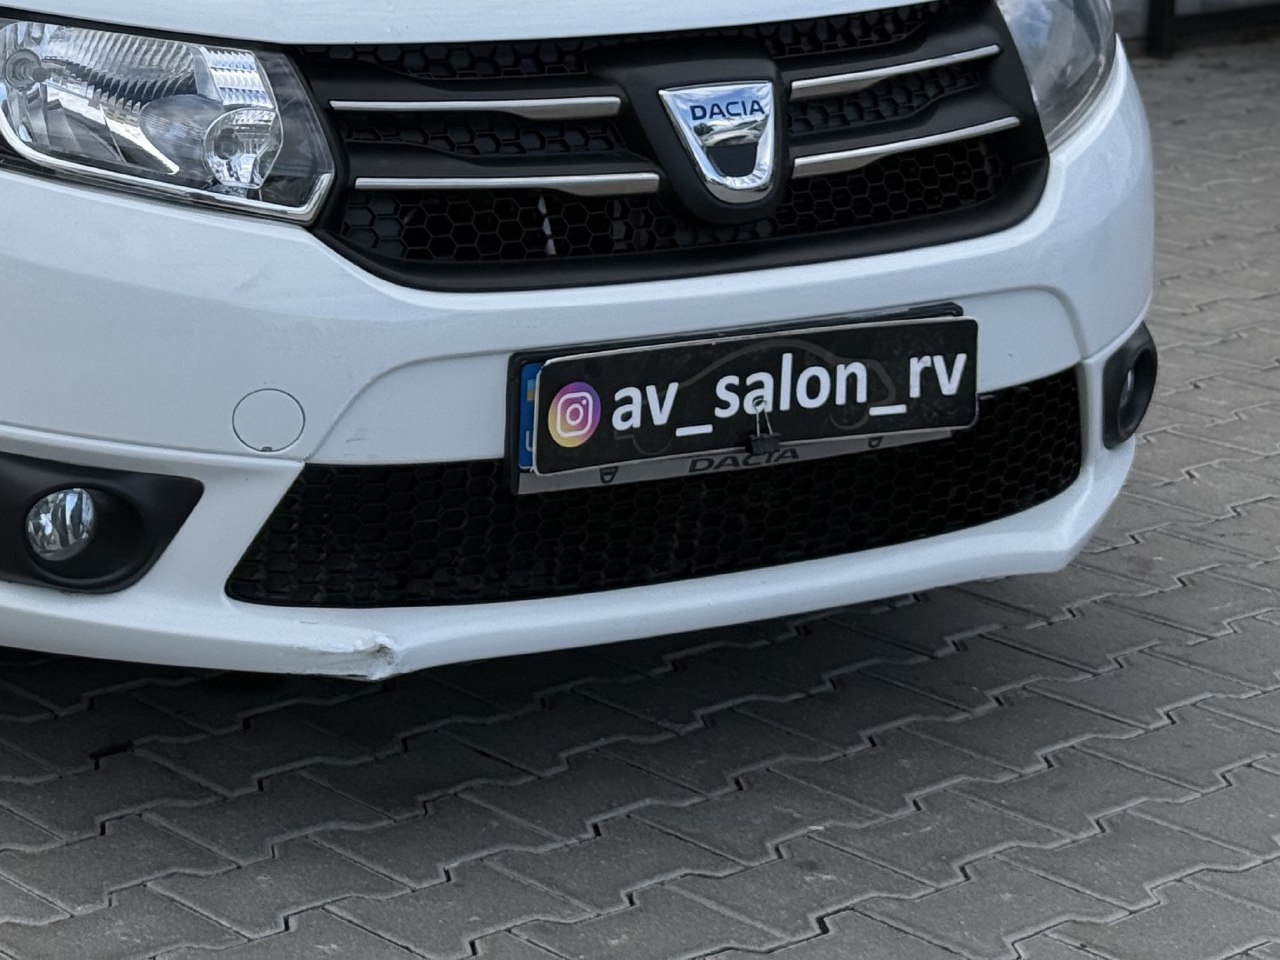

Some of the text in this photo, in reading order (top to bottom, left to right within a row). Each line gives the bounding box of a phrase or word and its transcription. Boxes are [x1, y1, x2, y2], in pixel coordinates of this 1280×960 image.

[689, 99, 765, 121] DACIA
[611, 351, 968, 438] av_salon_rv
[688, 447, 799, 473] DACIA
